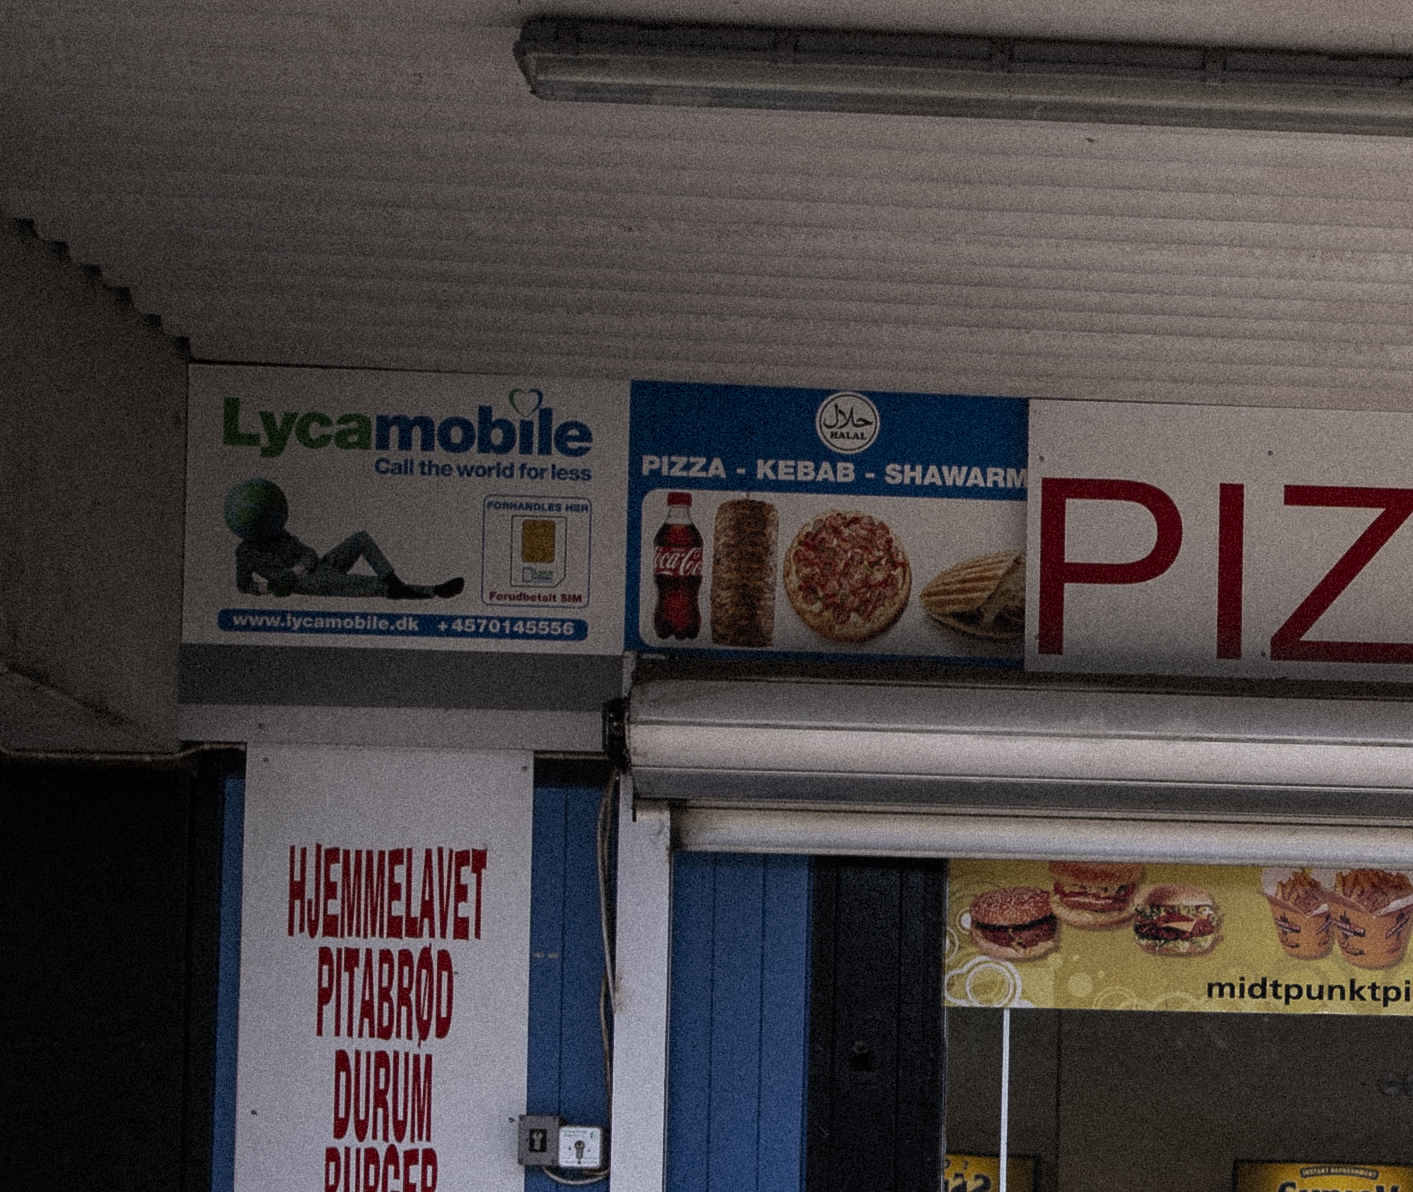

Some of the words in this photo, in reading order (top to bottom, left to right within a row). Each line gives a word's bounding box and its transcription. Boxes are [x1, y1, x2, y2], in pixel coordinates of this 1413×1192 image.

[223, 397, 593, 458] Lycamobile
[823, 402, 874, 430] حلال
[830, 431, 867, 440] HALAL
[375, 457, 414, 475] Call
[419, 460, 453, 477] the
[456, 463, 514, 479] world
[519, 463, 548, 480] for
[551, 464, 592, 481] less
[641, 455, 726, 479] PIZZA
[756, 459, 856, 483] KEBAB
[561, 594, 582, 603] SIM
[232, 613, 419, 633] www.lycamobile.dk
[438, 619, 575, 636] +4570145556
[288, 843, 487, 940] HJEMMELAVET
[316, 944, 454, 1048] PITABRØD
[333, 1049, 432, 1142] DURUM
